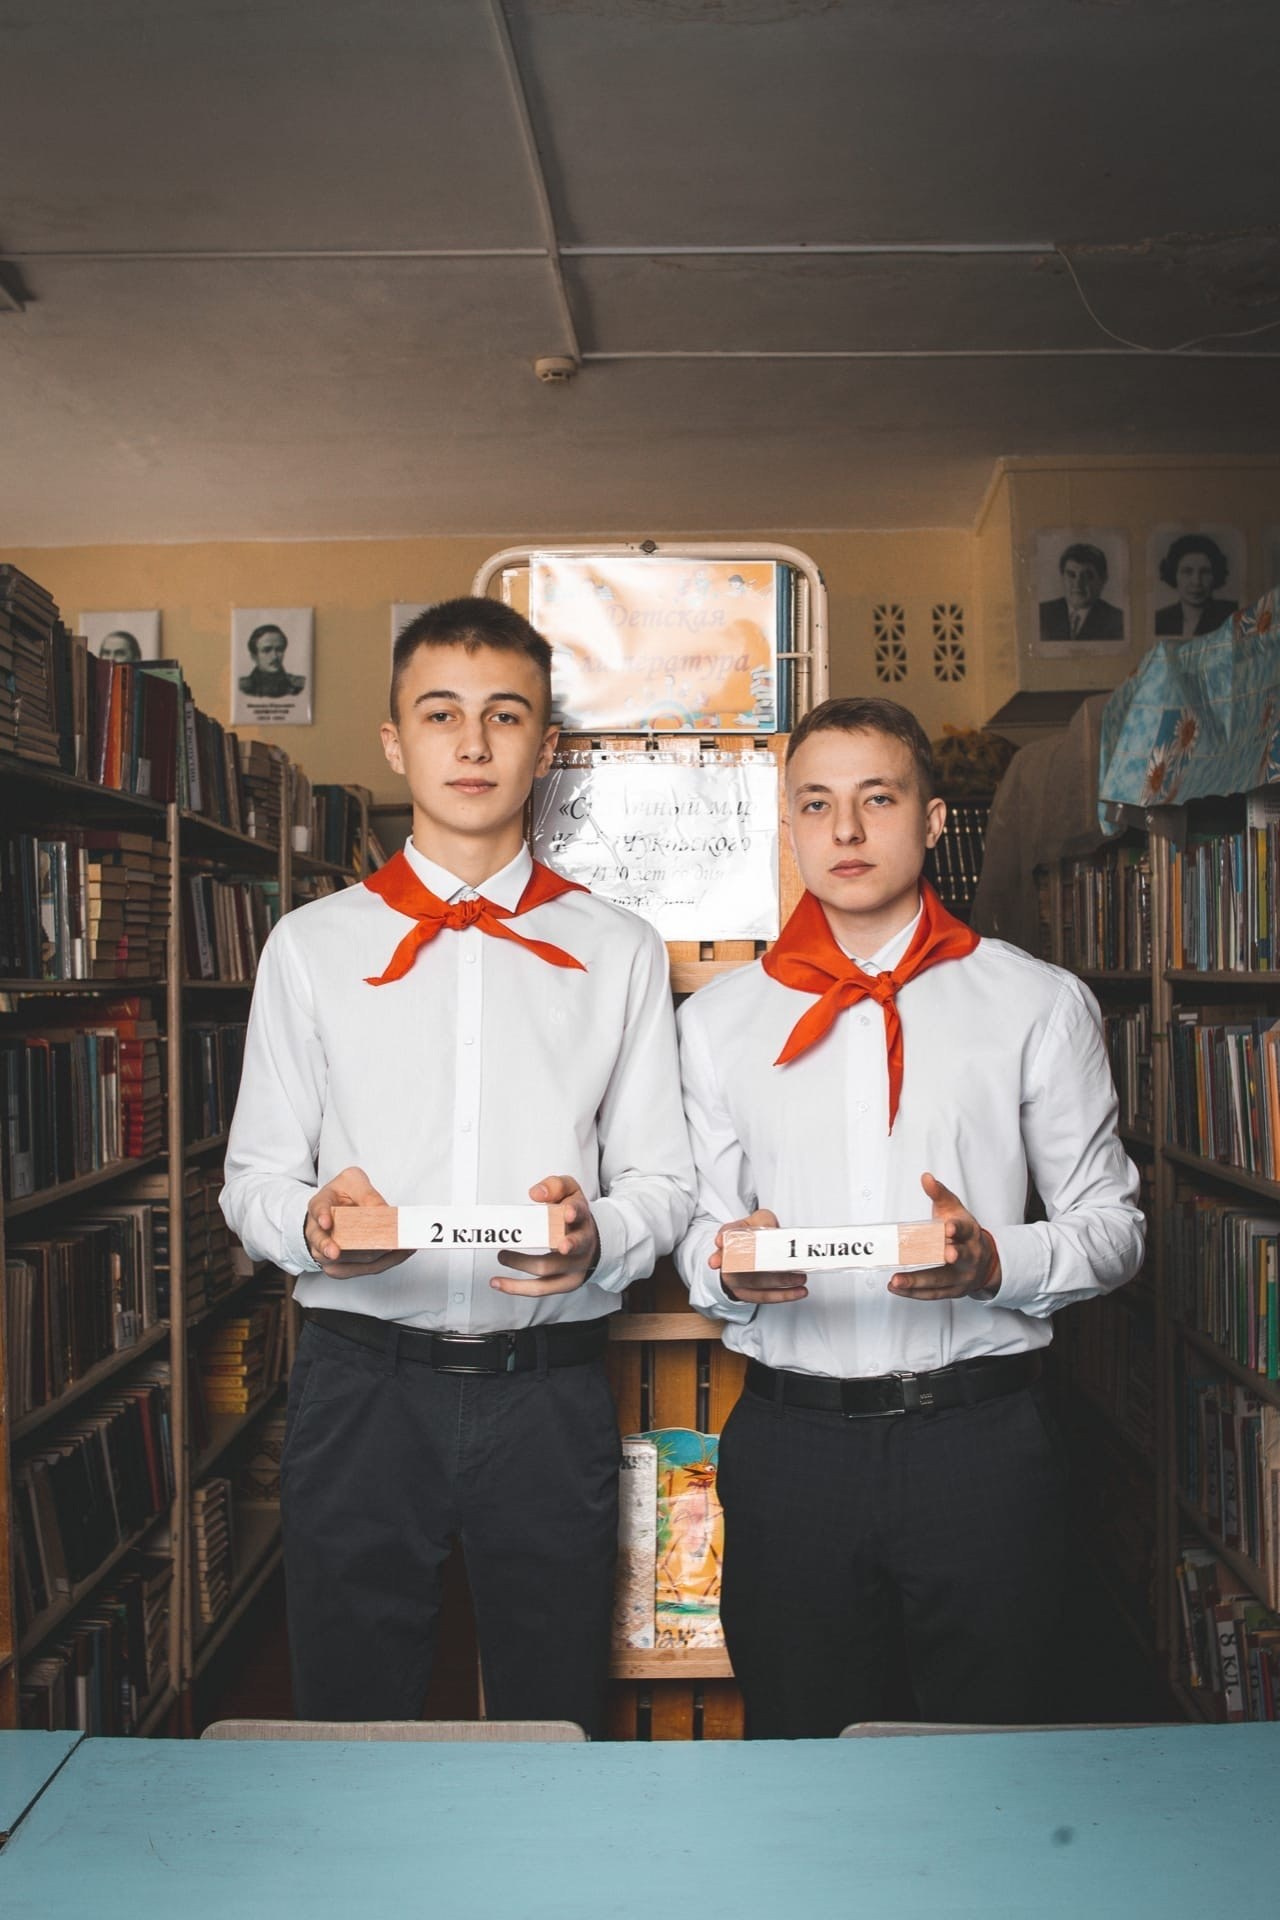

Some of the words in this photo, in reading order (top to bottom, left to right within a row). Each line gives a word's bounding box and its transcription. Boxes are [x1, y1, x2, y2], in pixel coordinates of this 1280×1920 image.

[607, 604, 727, 632] Детская
[430, 1222, 444, 1243] 2
[452, 1228, 522, 1243] класс
[788, 1239, 798, 1258] 1
[807, 1241, 875, 1257] класс
[1219, 1633, 1236, 1647] 8
